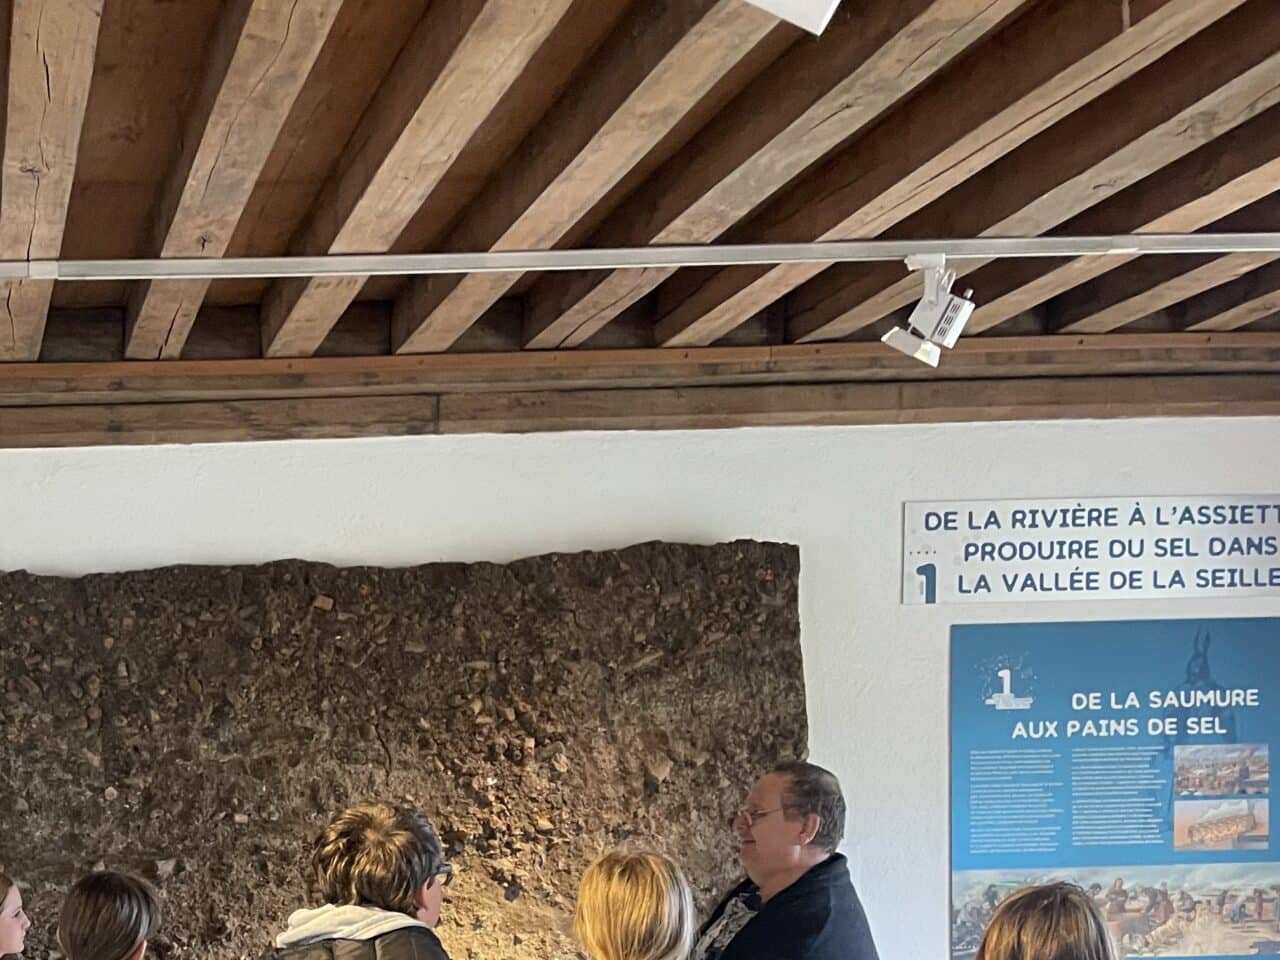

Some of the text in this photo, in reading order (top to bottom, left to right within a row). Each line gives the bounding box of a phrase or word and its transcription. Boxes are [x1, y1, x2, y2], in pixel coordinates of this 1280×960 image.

[924, 511, 958, 531] DE
[968, 510, 1001, 530] LA
[1011, 503, 1118, 529] RIVIÈRE
[1128, 501, 1146, 526] À
[964, 536, 1278, 562] PRODUIRE DU SEL DANS
[916, 563, 937, 604] 1
[958, 566, 1280, 594] LA VALLÉE DE LA SEILLE
[1071, 689, 1260, 710] DE LA SAUMURE
[1011, 716, 1227, 739] AUX PAINS DE SEL
